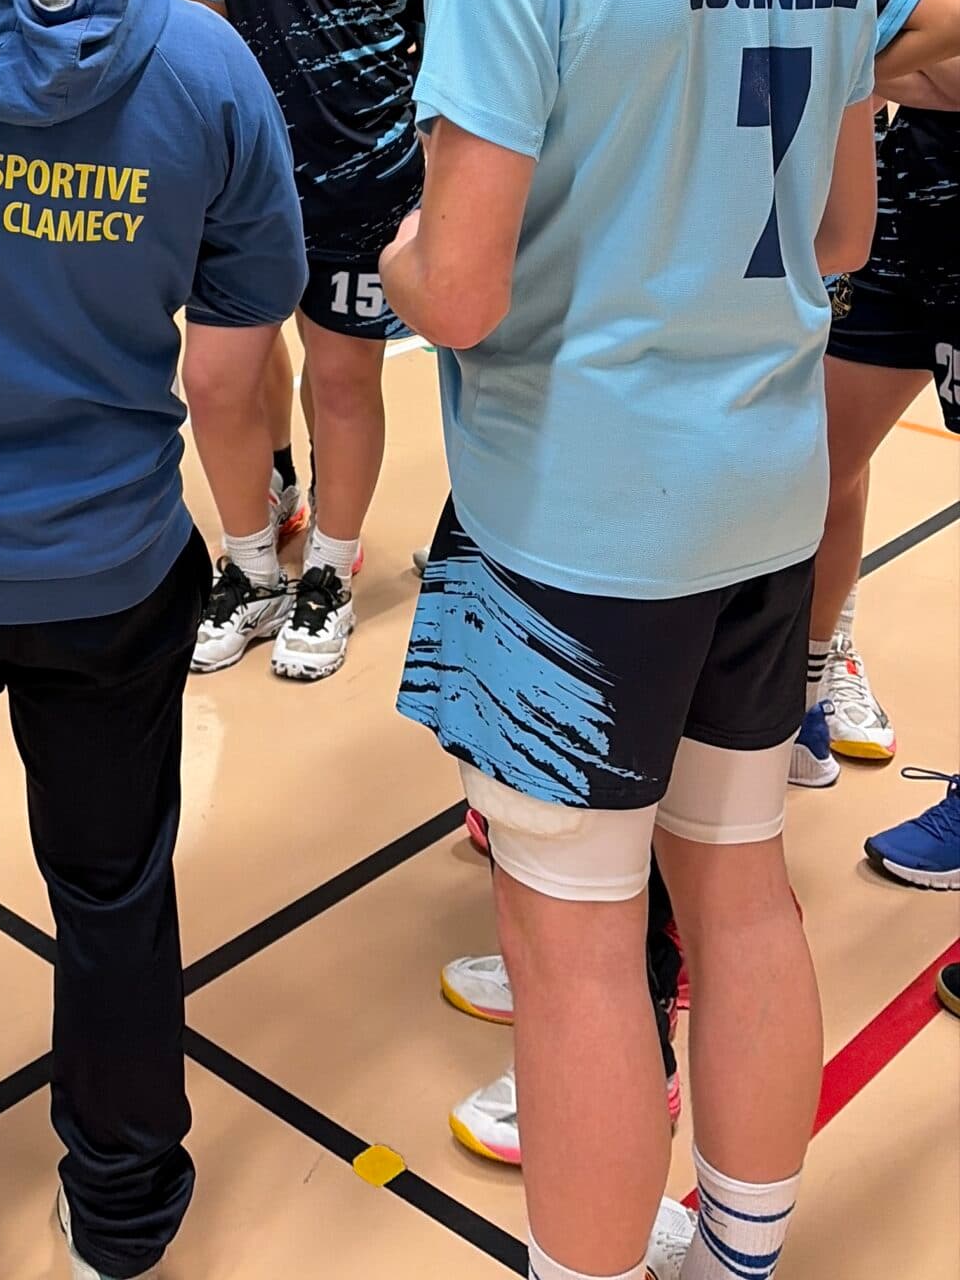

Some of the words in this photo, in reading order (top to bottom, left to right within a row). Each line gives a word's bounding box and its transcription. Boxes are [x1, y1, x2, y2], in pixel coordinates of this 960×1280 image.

[736, 47, 812, 278] 7
[2, 201, 145, 243] CLAMECY
[331, 271, 383, 317] 15
